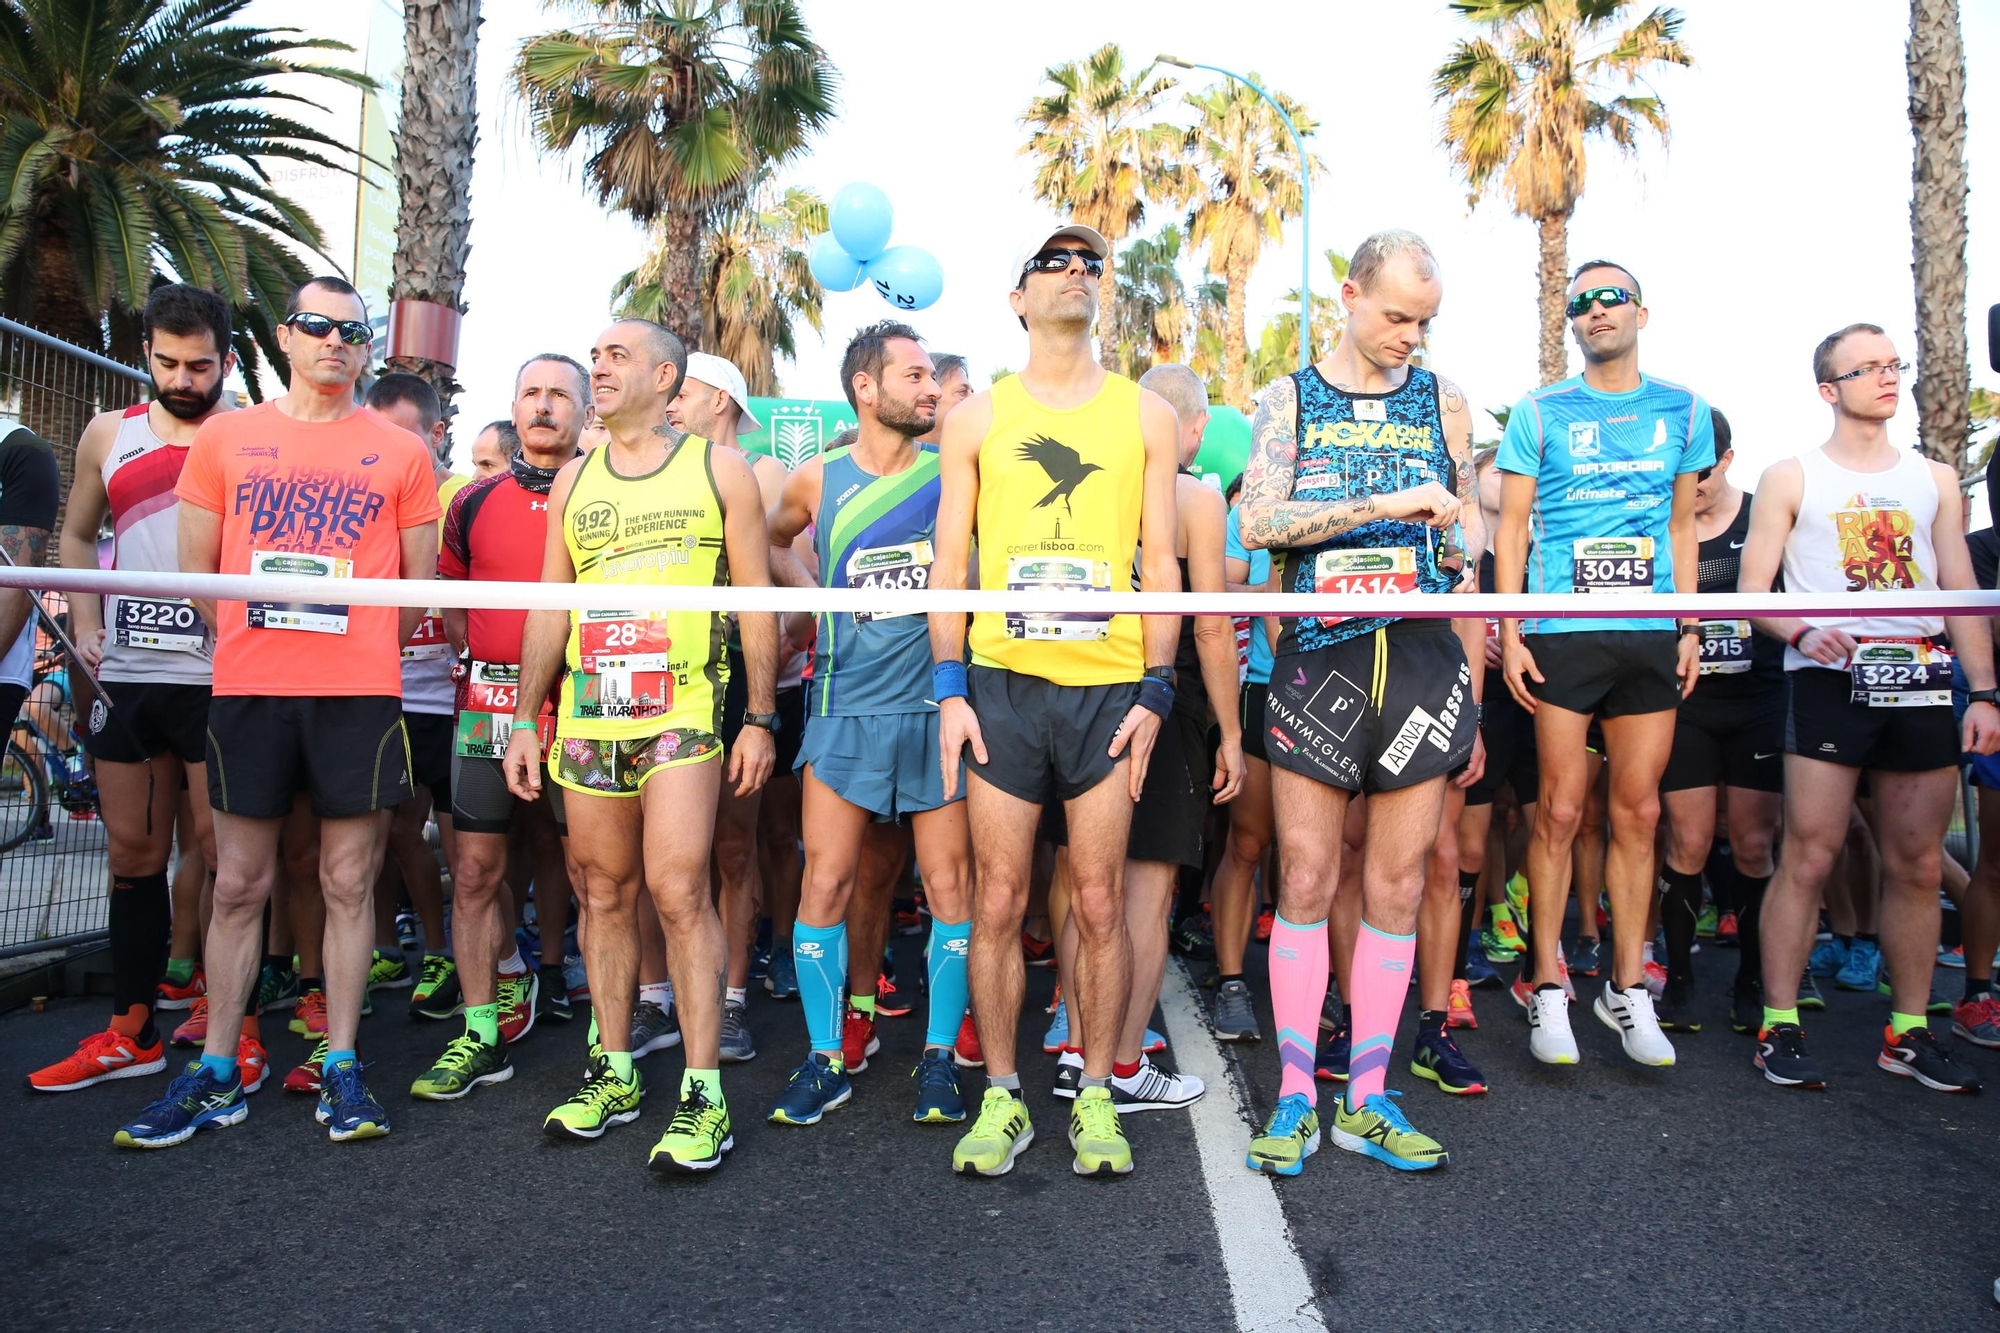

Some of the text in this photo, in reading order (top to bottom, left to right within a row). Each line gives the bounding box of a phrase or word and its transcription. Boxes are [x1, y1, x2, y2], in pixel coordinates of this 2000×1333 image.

[1304, 421, 1398, 449] HOKA
[1396, 425, 1432, 439] ONE
[1399, 438, 1434, 452] ONE
[244, 463, 372, 494] 42.195KM
[235, 479, 385, 522] FINISHER
[625, 509, 705, 526] THE NEW RUNNING
[248, 511, 366, 548] PARIS
[579, 529, 610, 544] RUNNING
[625, 519, 687, 538] EXPERIENCE
[626, 538, 658, 550] OFFICIAL TEAM
[1348, 555, 1381, 564] cajasiete
[861, 566, 927, 589] 4669
[1582, 560, 1648, 581] 3045
[1335, 577, 1400, 594] 1616
[126, 602, 194, 628] 3220
[605, 623, 637, 646] 28
[1862, 665, 1930, 685] 3224
[580, 704, 667, 717] TRAVEL MARATHON
[465, 744, 497, 755] TRAVEL
[1387, 720, 1425, 768] ARNA
[835, 986, 843, 1038] BOOSTER
